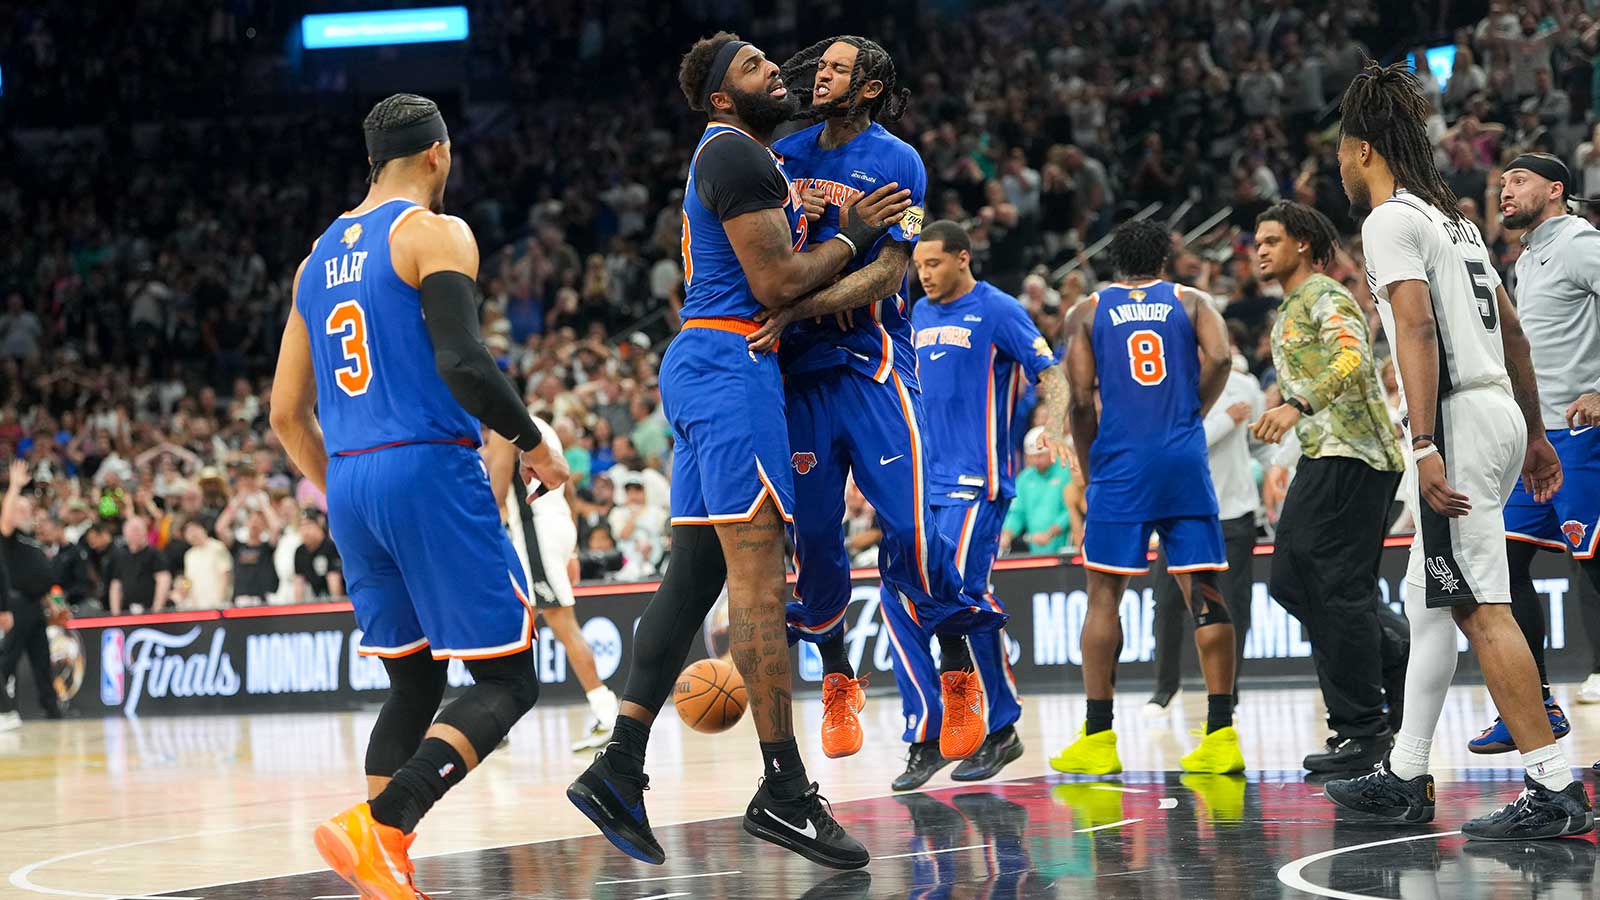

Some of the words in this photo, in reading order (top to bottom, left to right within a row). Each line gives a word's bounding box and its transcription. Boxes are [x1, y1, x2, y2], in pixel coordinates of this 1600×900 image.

[1108, 303, 1174, 327] ANUNOBY
[1463, 257, 1499, 334] 5
[326, 299, 374, 397] 3
[1126, 329, 1167, 387] 8
[123, 624, 241, 721] Finals
[246, 630, 343, 694] MONDAY
